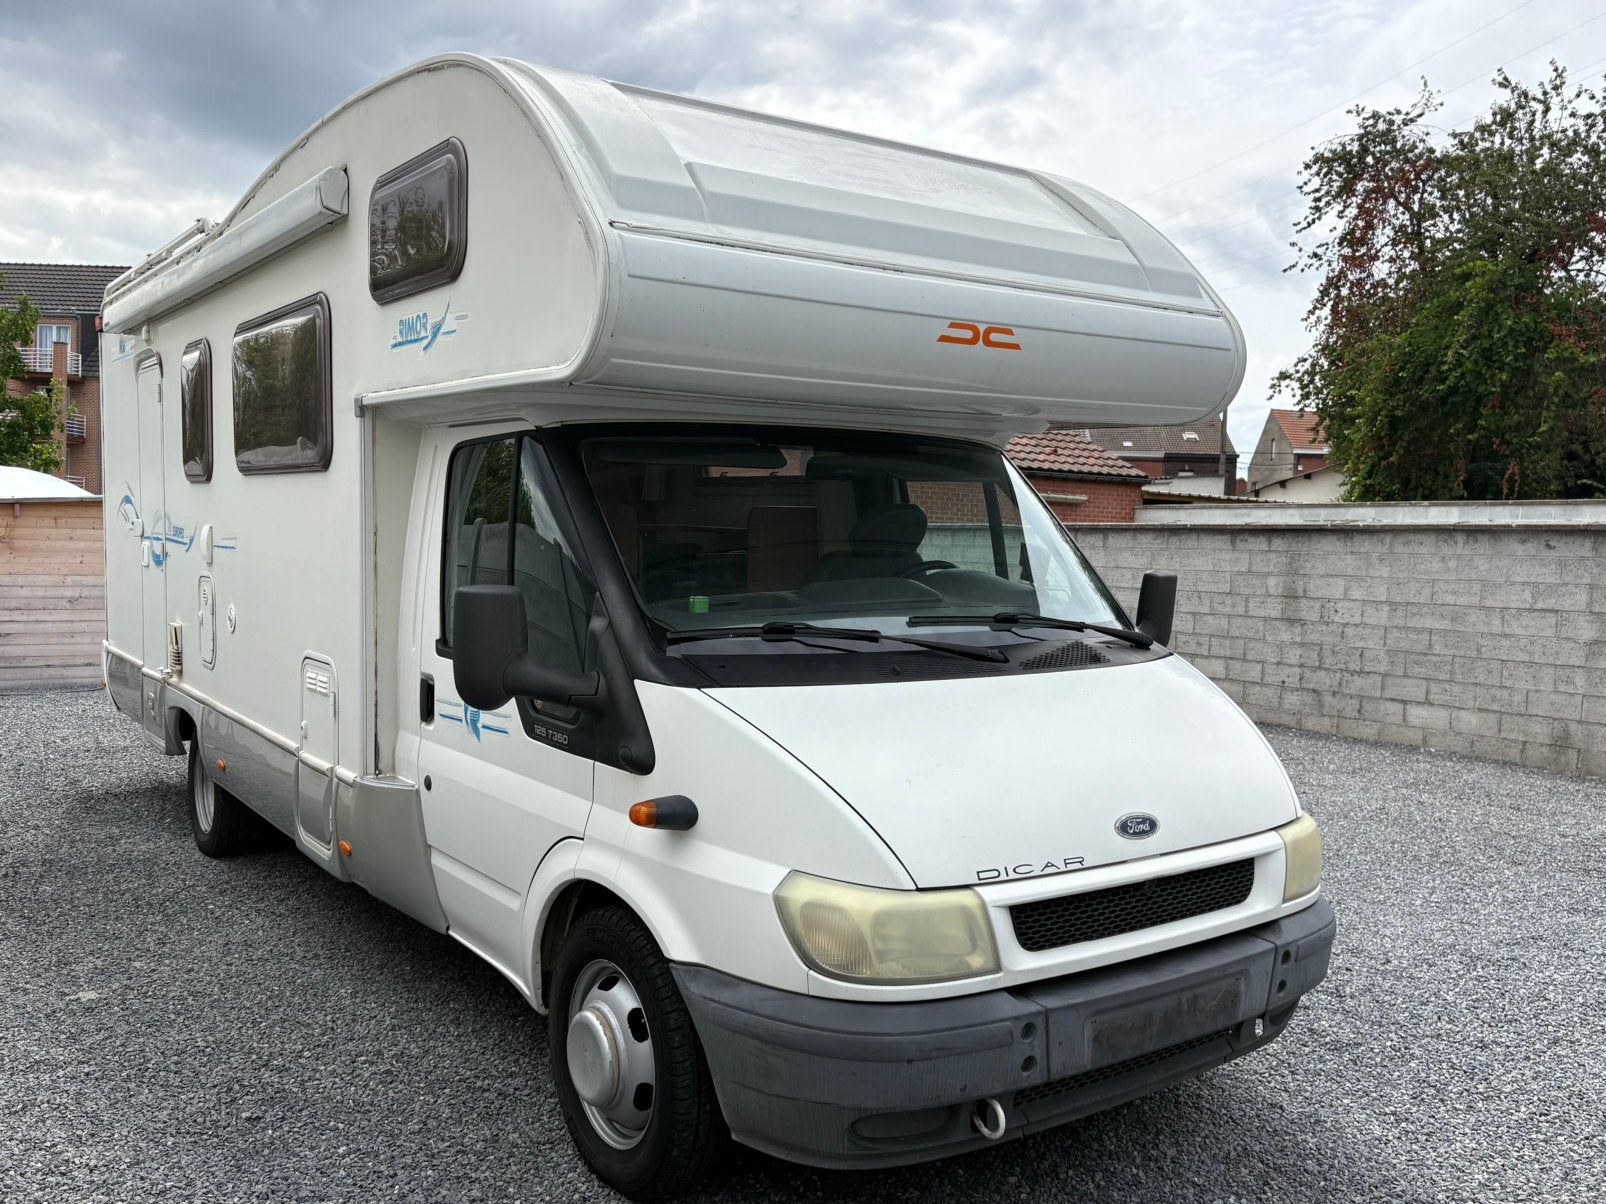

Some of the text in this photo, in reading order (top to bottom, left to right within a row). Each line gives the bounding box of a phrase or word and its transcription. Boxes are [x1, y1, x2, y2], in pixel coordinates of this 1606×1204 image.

[398, 312, 428, 340] RIMOR
[534, 724, 568, 744] 125 T350
[1127, 818, 1151, 833] Ford
[976, 856, 1086, 882] DICAR
